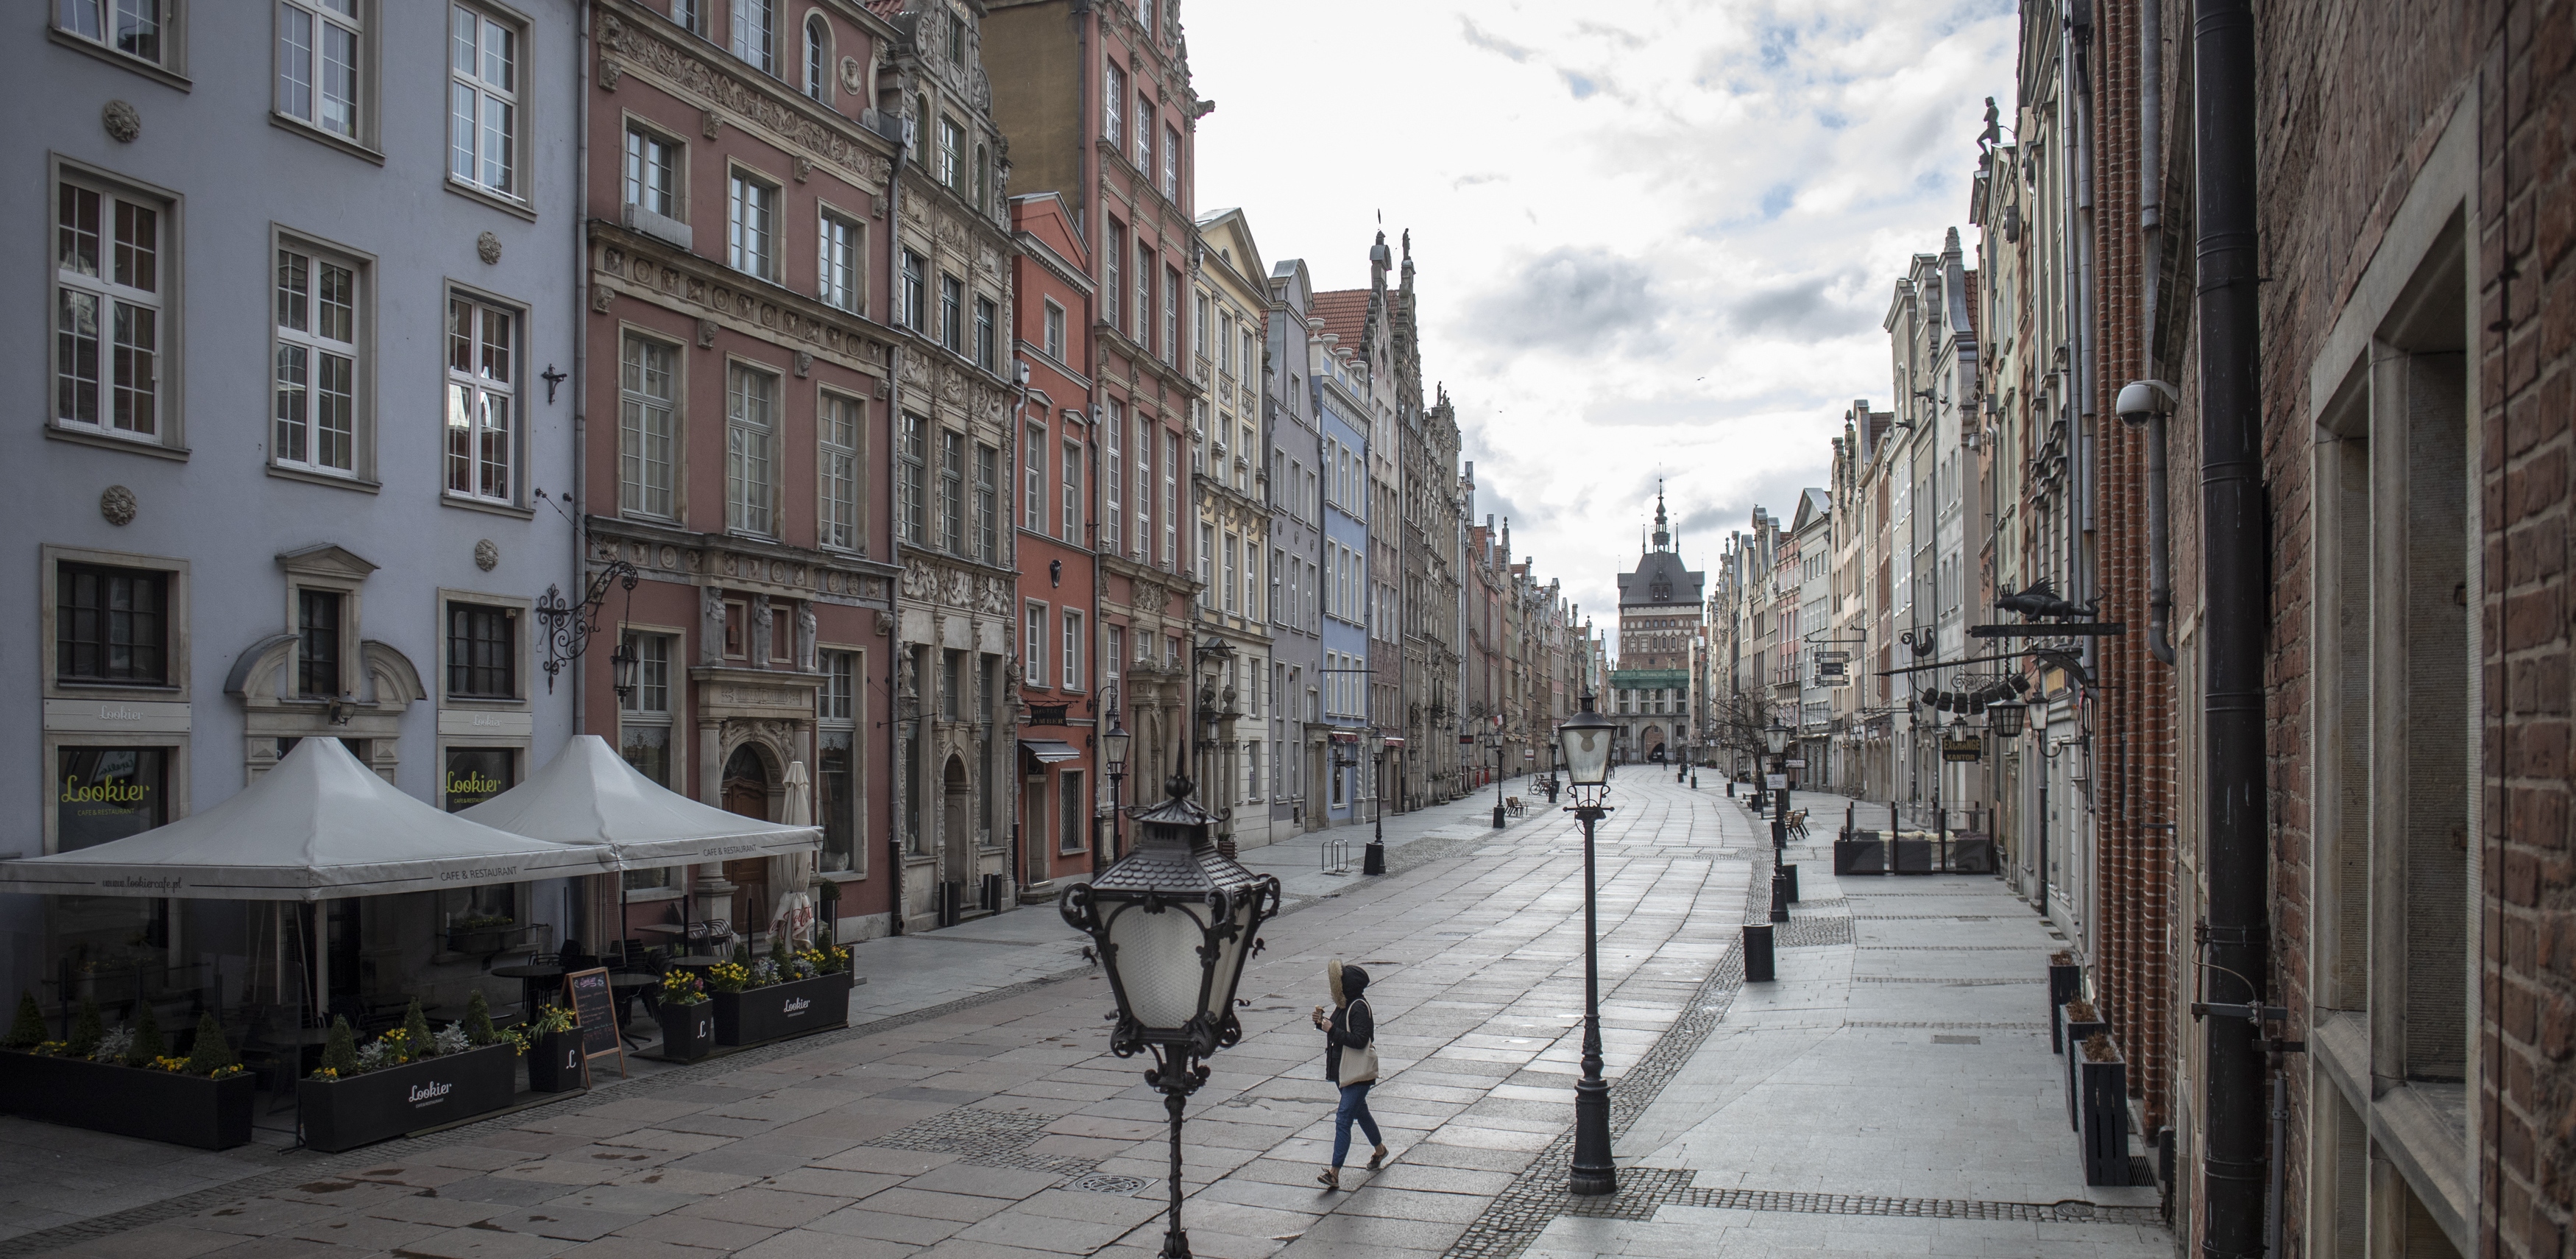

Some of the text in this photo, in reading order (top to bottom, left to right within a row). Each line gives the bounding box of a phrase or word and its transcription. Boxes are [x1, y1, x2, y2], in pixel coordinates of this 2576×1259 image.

[98, 705, 144, 721] Lookier
[473, 714, 502, 727] Lookier
[1944, 738, 1981, 750] EXCHANGE
[61, 774, 150, 803] Lookier
[446, 771, 501, 794] Lookier
[97, 808, 135, 816] RESTAURANT
[703, 848, 717, 857] CAFE
[723, 844, 757, 855] RESTAURANT
[440, 866, 517, 881] CAFE & RESTAURANT
[102, 876, 182, 893] www.lookiercafe.pl
[783, 997, 810, 1013] Lookier
[408, 1080, 452, 1103] Lookier
